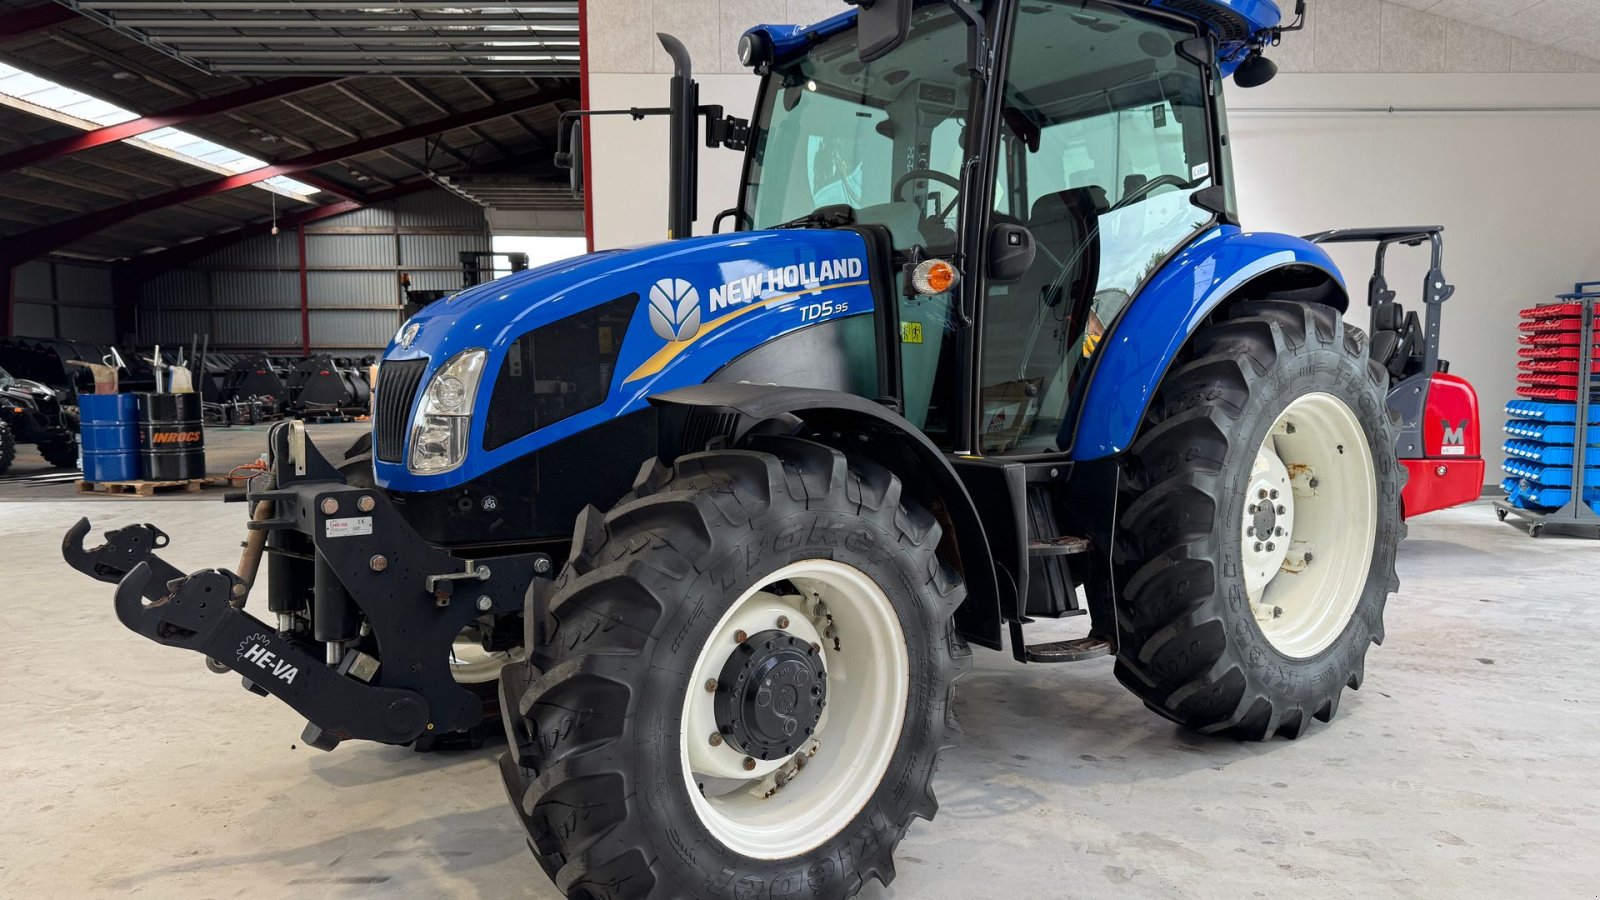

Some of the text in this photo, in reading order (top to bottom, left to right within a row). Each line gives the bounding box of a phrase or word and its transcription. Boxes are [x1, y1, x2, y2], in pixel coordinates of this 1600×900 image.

[709, 257, 863, 313] NEW HOLLAND
[799, 299, 849, 322] TD5.95
[152, 431, 201, 443] INROCS
[243, 643, 299, 685] HE-VA
